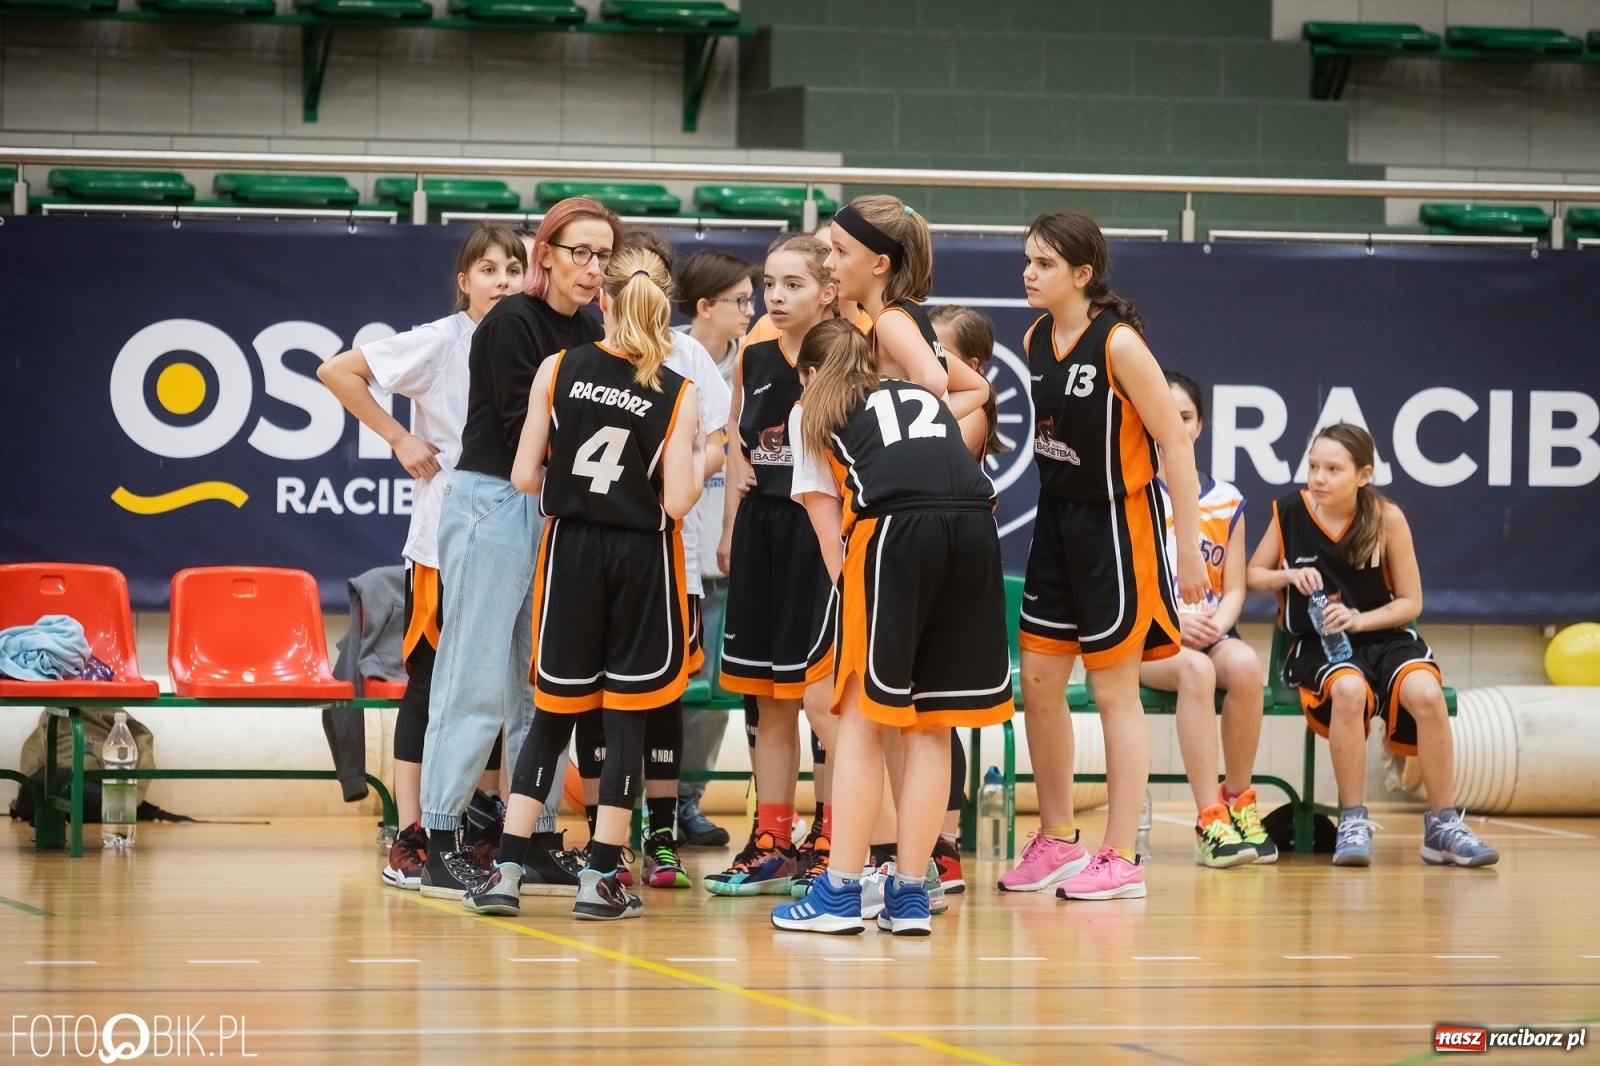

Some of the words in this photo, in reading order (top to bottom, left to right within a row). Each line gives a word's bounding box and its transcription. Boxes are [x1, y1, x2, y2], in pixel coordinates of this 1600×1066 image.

[1065, 364, 1097, 397] 13
[569, 381, 652, 417] RACIBÓRZ
[865, 388, 947, 447] 12
[572, 426, 630, 494] 4
[753, 453, 794, 462] BASKE
[658, 750, 673, 763] NBA
